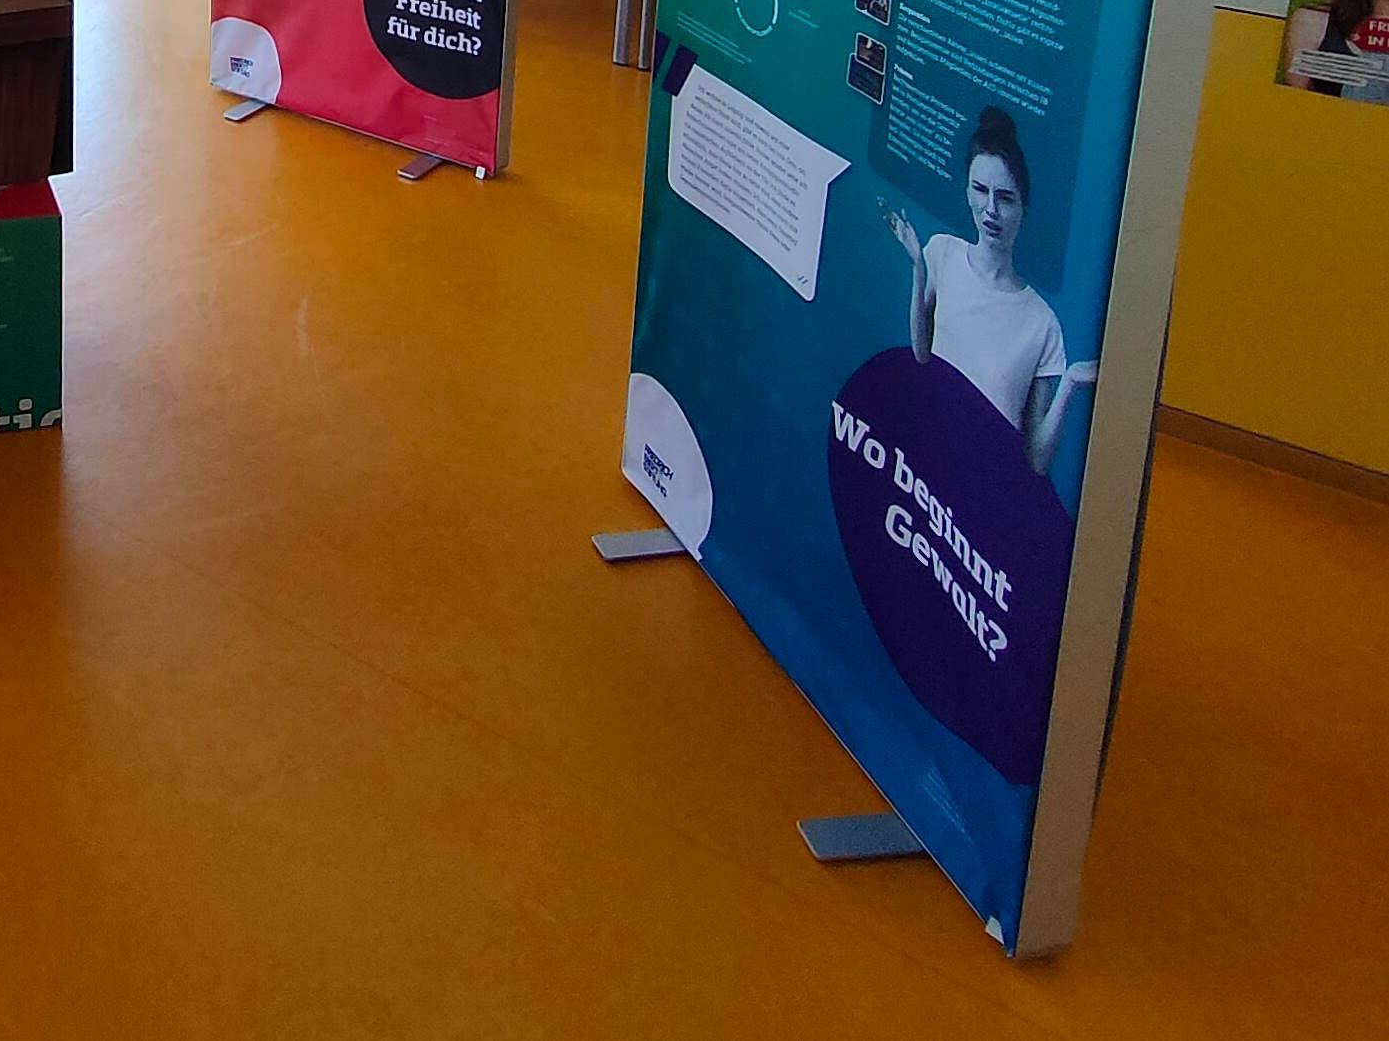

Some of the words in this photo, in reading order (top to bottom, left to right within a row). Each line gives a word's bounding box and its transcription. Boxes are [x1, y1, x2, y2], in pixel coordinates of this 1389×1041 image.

[387, 16, 418, 42] für
[423, 25, 482, 57] dich?
[831, 399, 885, 470] Wo
[893, 447, 1014, 612] beginnt
[884, 503, 1010, 663] Gewalt?
